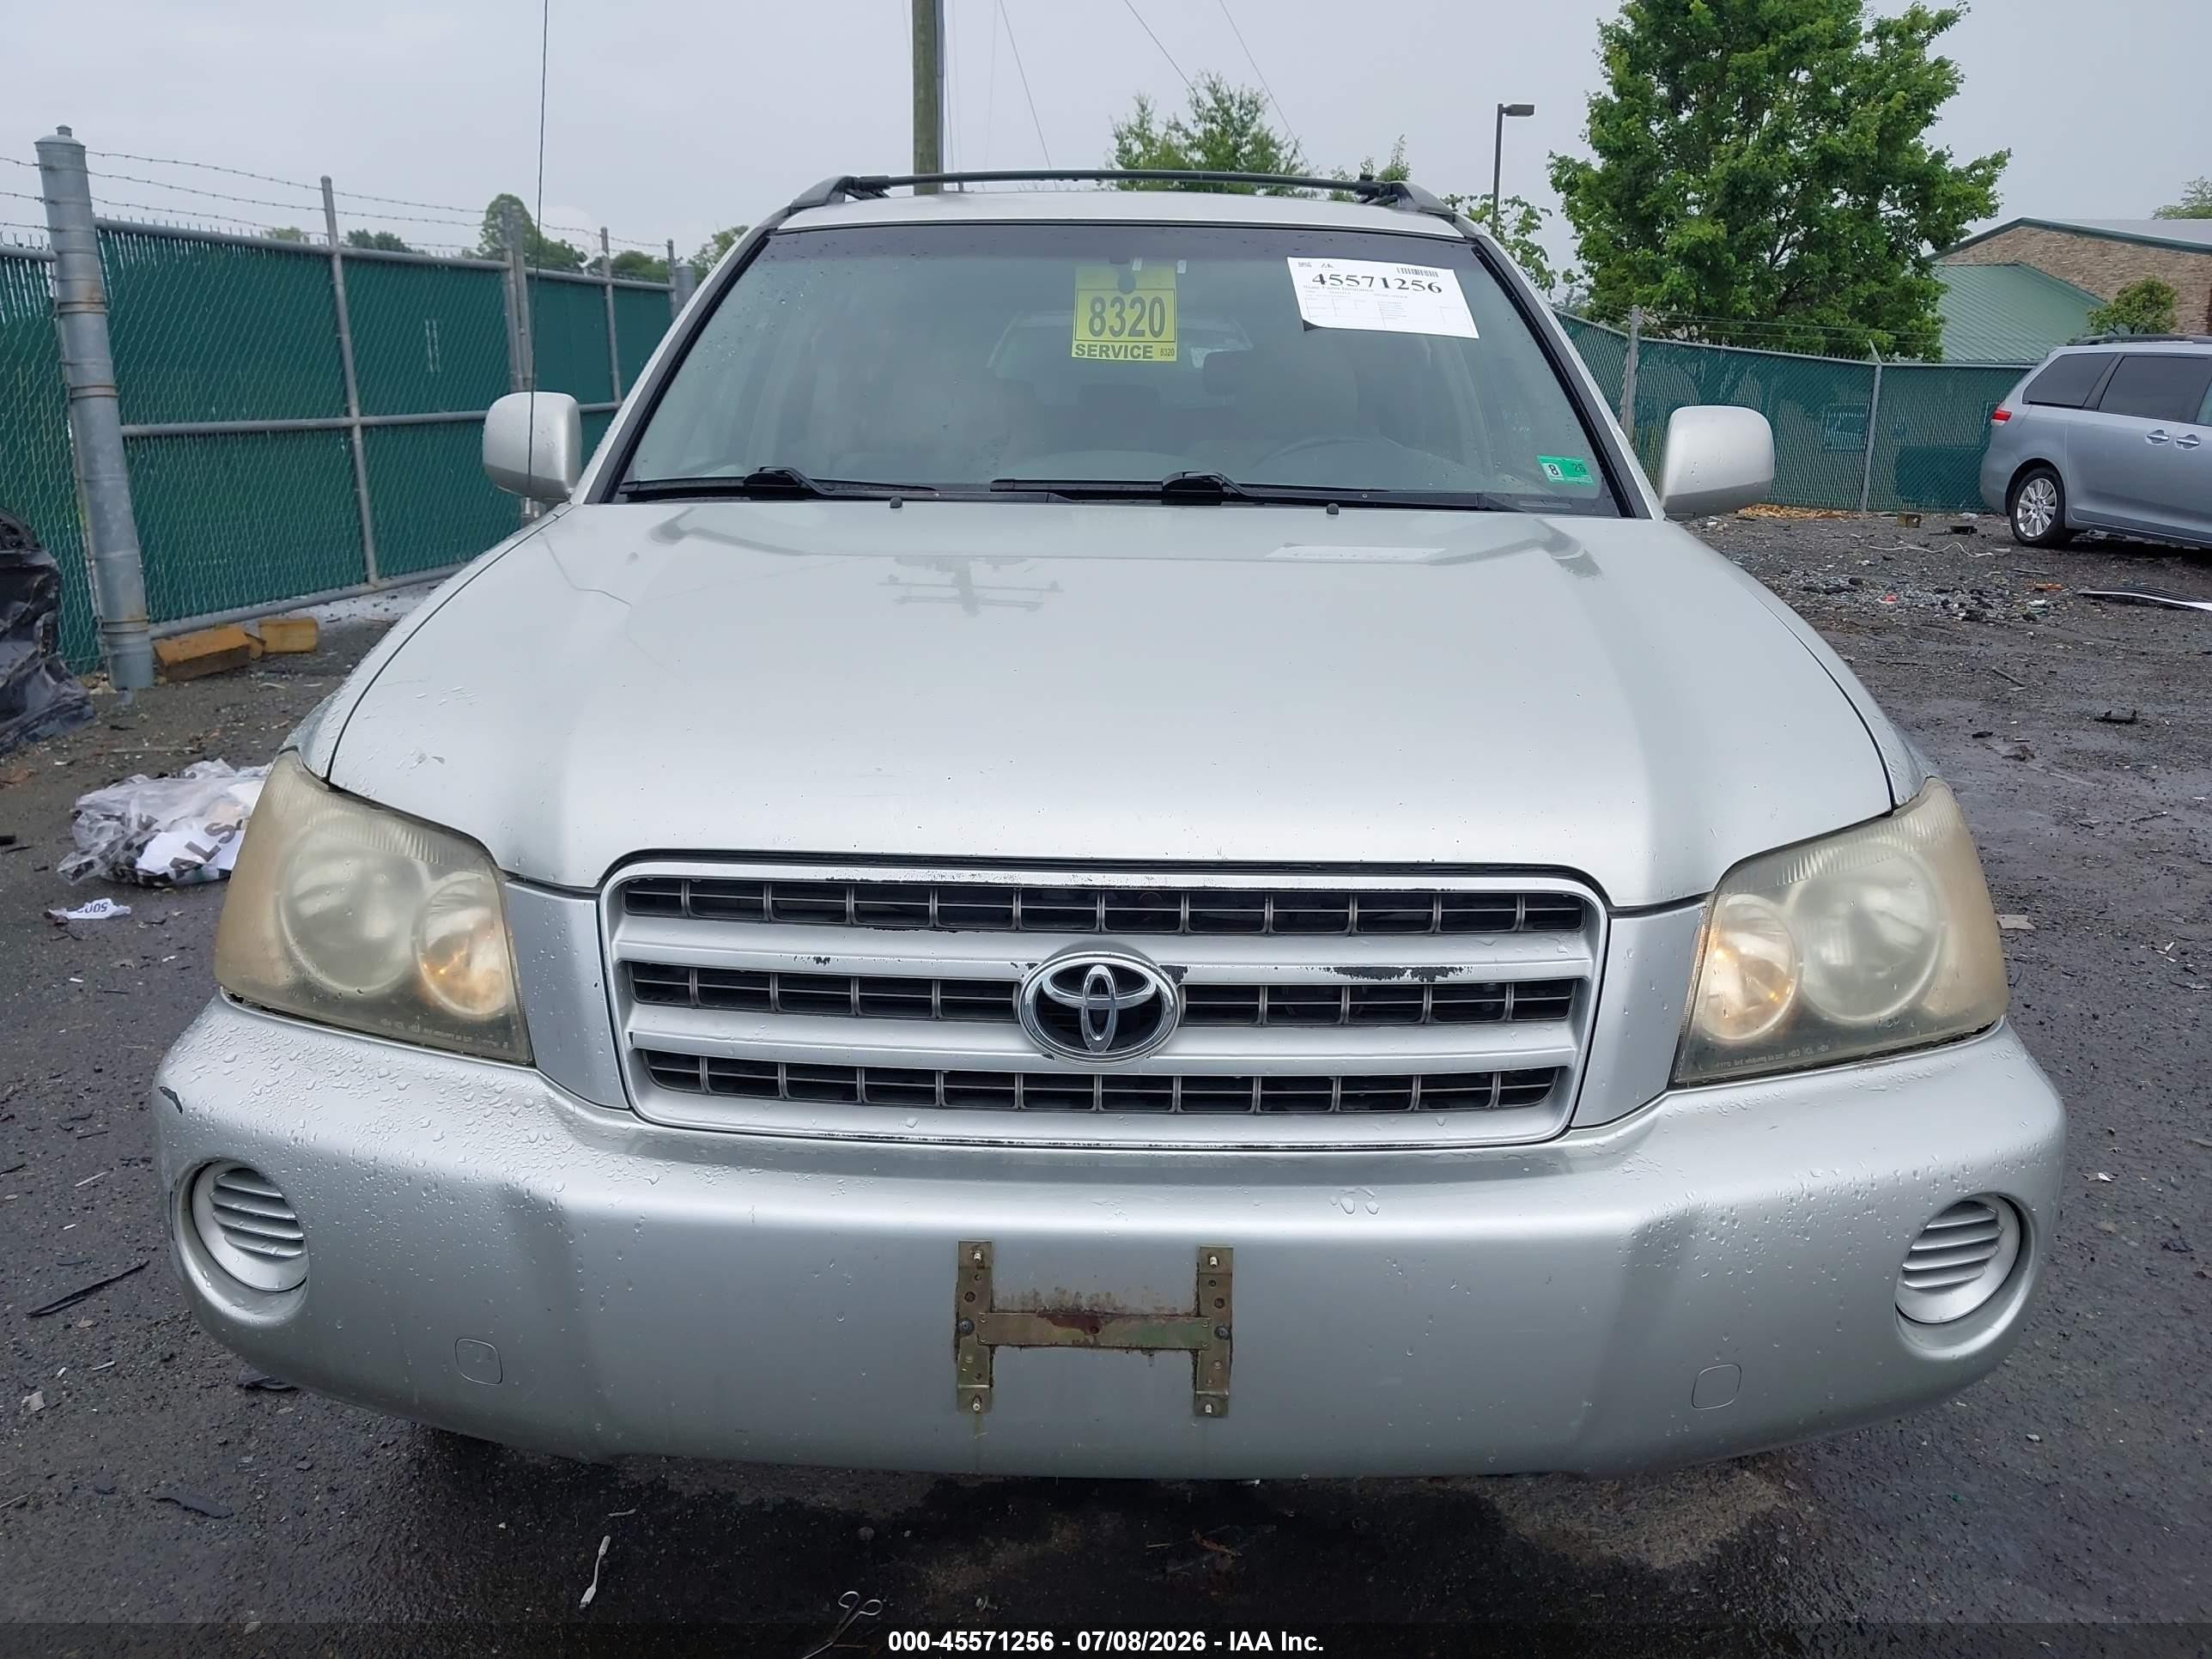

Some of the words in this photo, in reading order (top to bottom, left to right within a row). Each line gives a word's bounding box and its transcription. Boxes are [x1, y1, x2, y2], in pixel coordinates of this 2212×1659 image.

[1312, 273, 1443, 294] 45571256
[1089, 296, 1165, 337] 8320
[1075, 343, 1153, 359] SERVICE
[1548, 465, 1559, 475] 8
